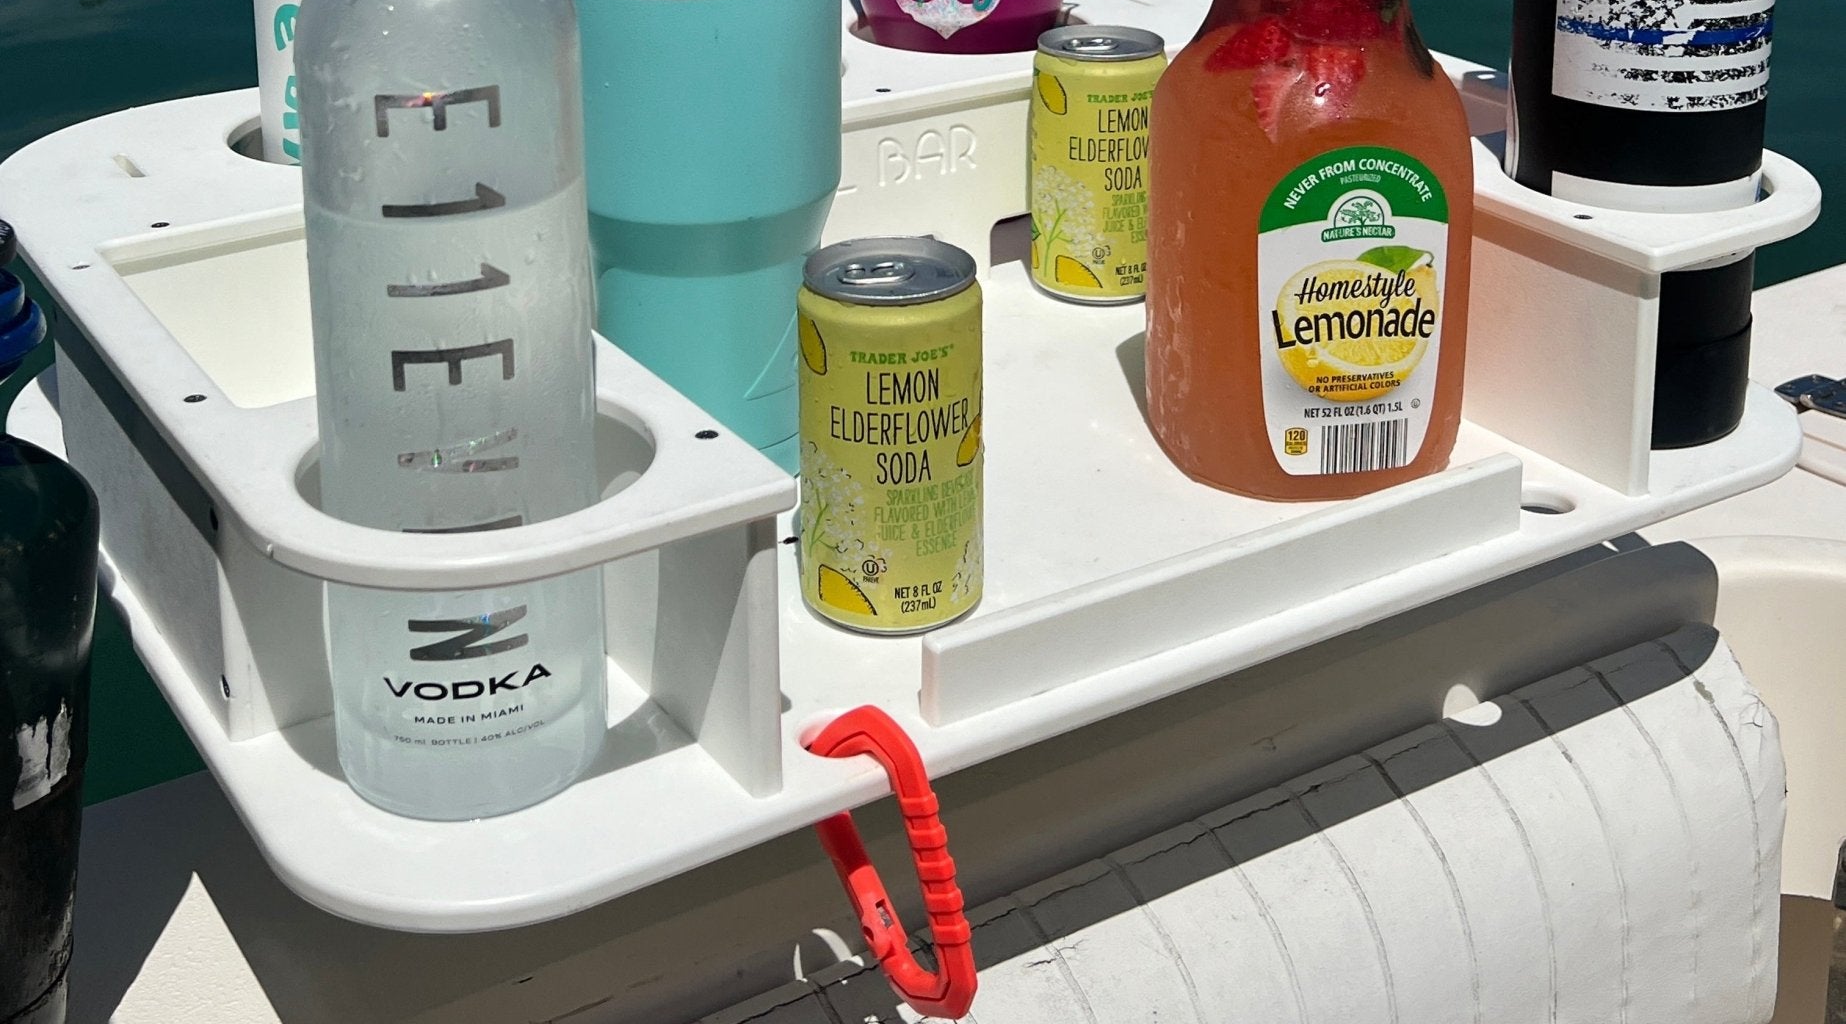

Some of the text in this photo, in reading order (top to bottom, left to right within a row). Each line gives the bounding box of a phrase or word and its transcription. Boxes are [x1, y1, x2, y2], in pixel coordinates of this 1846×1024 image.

[1087, 94, 1128, 103] TRADER
[1098, 106, 1148, 133] LEMON
[878, 123, 977, 187] BAR
[1104, 165, 1142, 191] SODA
[1284, 158, 1433, 210] NEVER FROM CONCENTRATE
[1323, 226, 1393, 241] NATURE'S NECTAR
[1294, 269, 1416, 309] Homestyle
[1272, 298, 1435, 349] Lemonade
[850, 345, 950, 364] TRADER JOE'S
[866, 368, 939, 406] LEMON
[1308, 379, 1401, 393] OR ARTIFICIAL COLORS
[1316, 371, 1394, 384] NO PRESERVATIVES
[1304, 408, 1320, 418] NET
[1322, 407, 1332, 417] 52
[1333, 407, 1342, 416] FL
[1344, 405, 1355, 416] OZ
[1388, 401, 1403, 412] 1.5L
[831, 398, 969, 446] ELDERFLOWER
[1288, 430, 1306, 441] 120
[876, 449, 932, 485] SODA
[874, 504, 929, 524] FLAVORED
[894, 581, 943, 599] NET 8 FL OZ
[901, 597, 937, 614] (237mL)
[383, 663, 552, 701] VODKA
[414, 704, 524, 724] MADE IN MIAMI
[431, 737, 471, 746] BOTTLE
[481, 733, 502, 742] 40%
